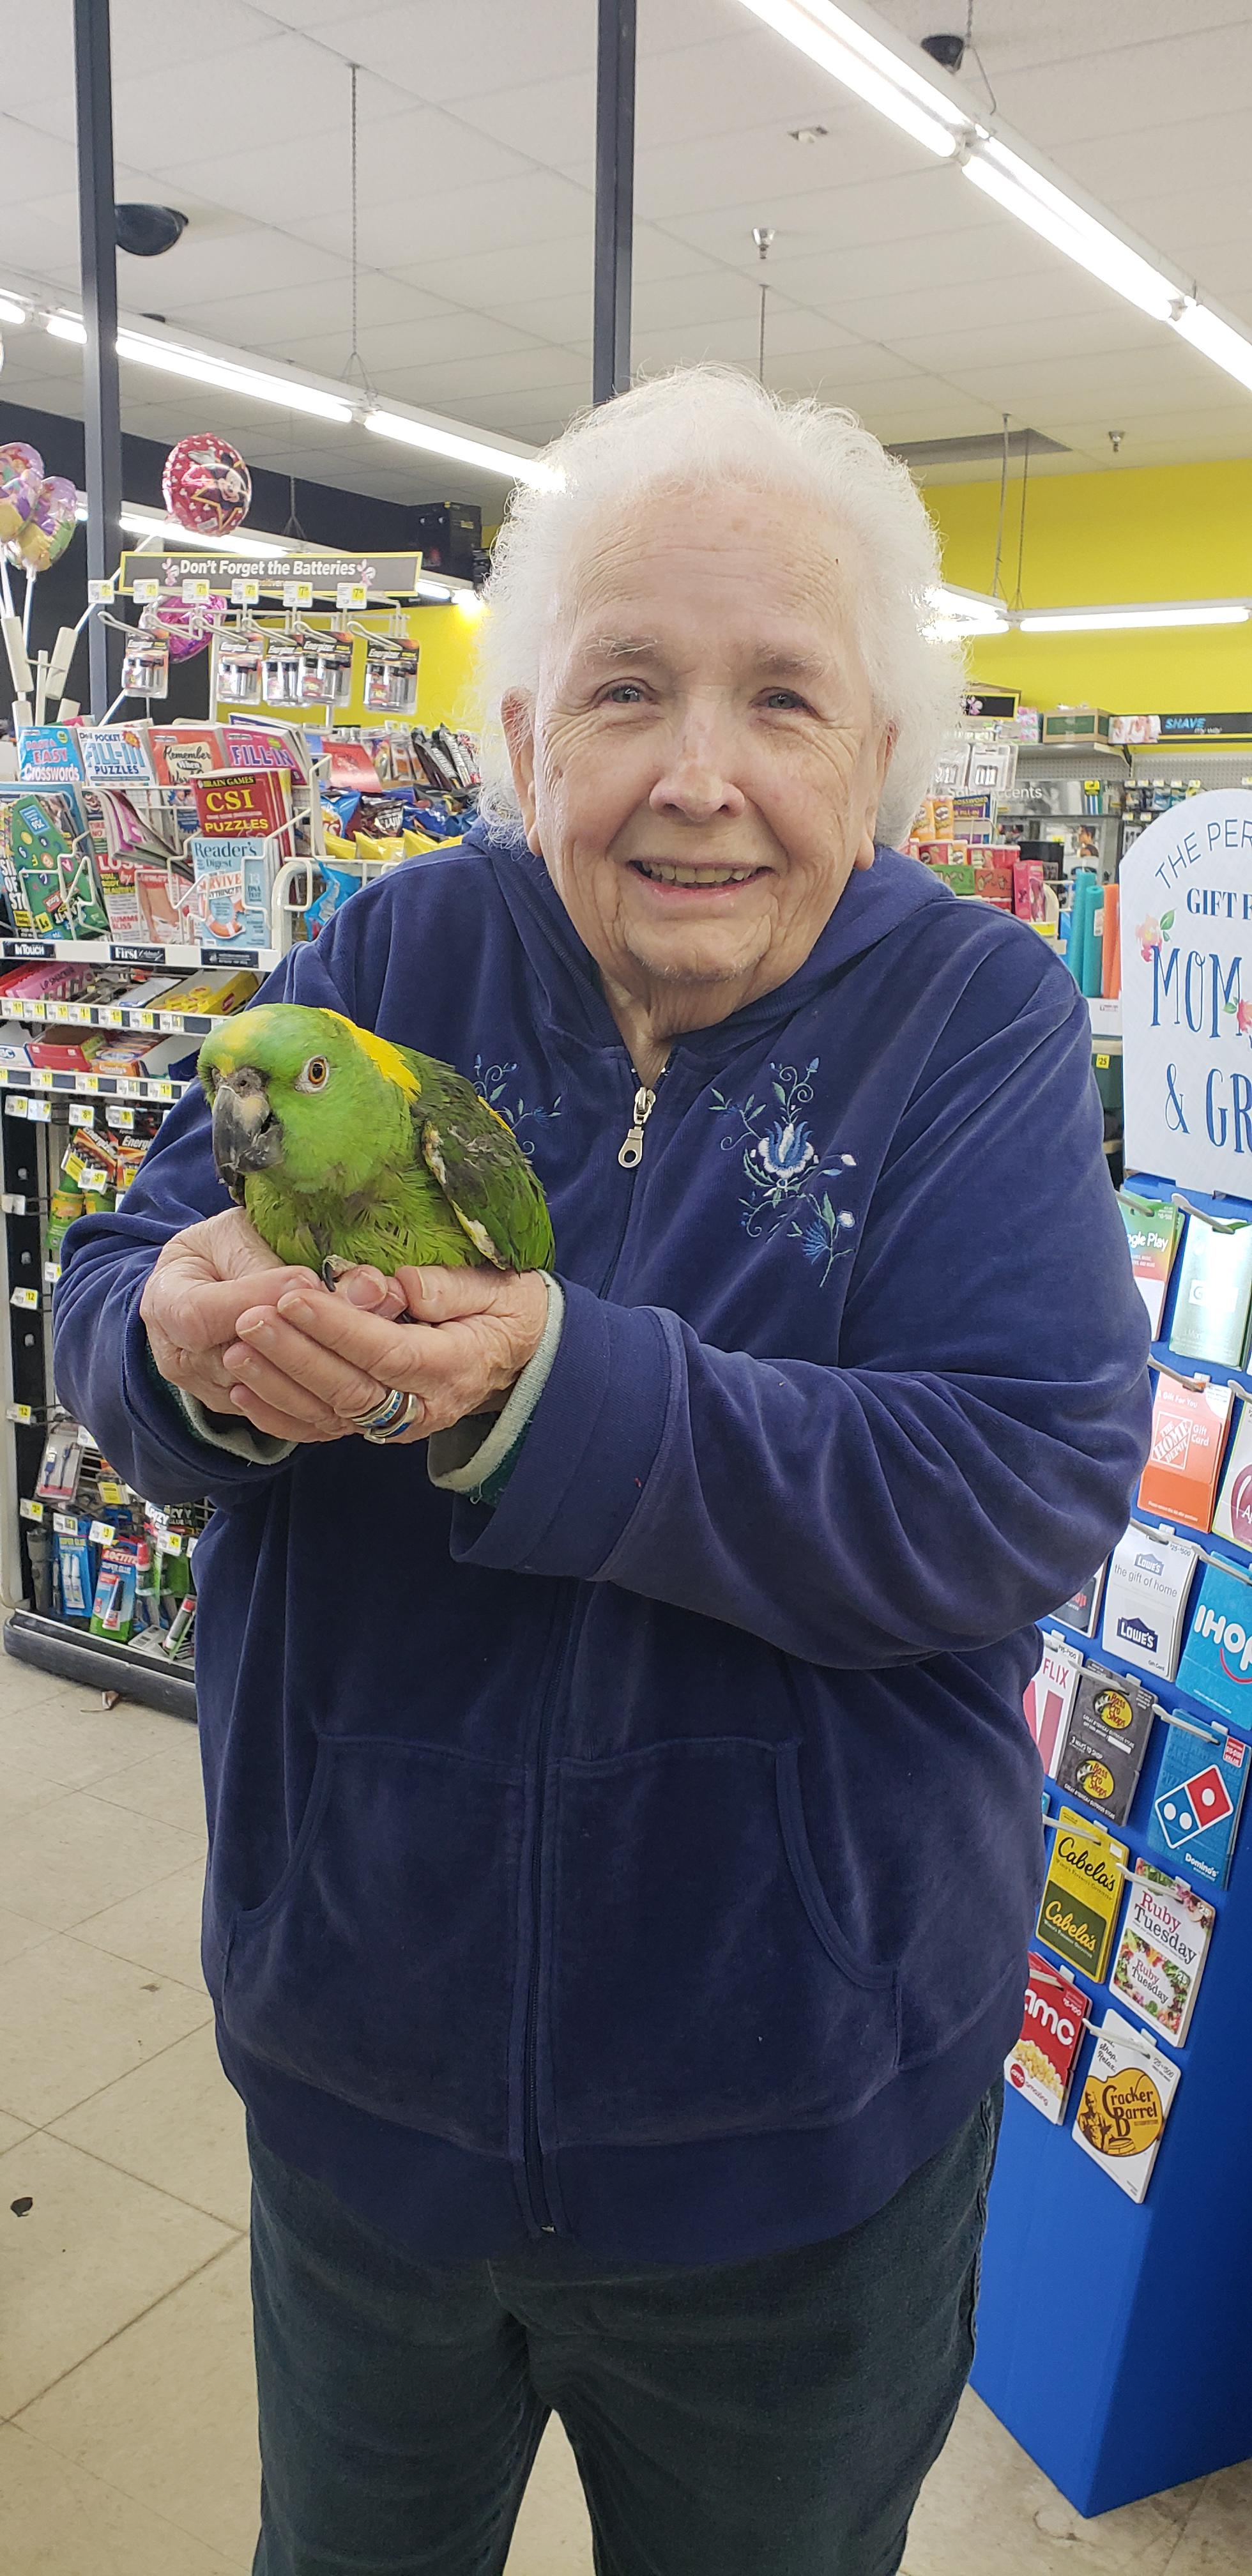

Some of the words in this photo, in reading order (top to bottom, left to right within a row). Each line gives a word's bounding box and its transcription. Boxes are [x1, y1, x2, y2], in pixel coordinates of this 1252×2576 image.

[180, 560, 217, 574] Don't
[219, 560, 264, 577] Forget
[268, 561, 291, 575] the
[293, 560, 356, 575] Batteries
[1165, 717, 1206, 729] SHAVE
[95, 733, 121, 742] POCKET
[33, 748, 68, 765] EASY
[163, 745, 211, 760] Remember
[231, 744, 295, 767] FILL-IN
[24, 762, 79, 781] Crosswords
[95, 765, 139, 774] PUZZLES
[226, 776, 254, 786] GAMES
[206, 790, 255, 812] CSI
[204, 819, 269, 833] PUZZLES
[194, 841, 257, 859] Reader's
[206, 859, 232, 870] Digest
[1155, 832, 1201, 889] THE
[4, 876, 18, 893] OF
[249, 873, 260, 885] 13
[1187, 888, 1237, 918] GIFT
[115, 947, 138, 960] First
[1165, 1063, 1190, 1134] &
[1147, 1232, 1169, 1252] Play
[1163, 1391, 1174, 1402] Gift
[1175, 1394, 1186, 1404] For
[1187, 1397, 1198, 1409] You
[1159, 1420, 1175, 1438] THE
[1193, 1423, 1207, 1436] Gift
[1153, 1419, 1191, 1460] HOME
[1192, 1436, 1210, 1447] Card
[1164, 1439, 1189, 1464] DEPOT
[1137, 1556, 1161, 1573] LOWE'S
[1115, 1564, 1127, 1577] the
[1129, 1570, 1142, 1584] gift
[1143, 1575, 1153, 1587] of
[1154, 1581, 1178, 1597] home
[1120, 1621, 1155, 1648] LOWE'S
[1042, 1657, 1069, 1689] FLIX
[1111, 1693, 1126, 1708] Bass
[1106, 1712, 1126, 1726] Shops
[1092, 1763, 1108, 1779] Bass
[1088, 1779, 1107, 1797] Shops
[1058, 1836, 1117, 1892] Cabela's
[1185, 1852, 1219, 1877] Domino's
[1140, 1890, 1181, 1934] Ruby
[1045, 1901, 1096, 1952] Cabela's
[1134, 1903, 1198, 1965] Tuesday
[1135, 1958, 1160, 1985] Ruby
[1131, 1966, 1169, 2004] Tuesday
[1102, 2084, 1154, 2119] Cracker
[1114, 2102, 1158, 2137] Barrel
